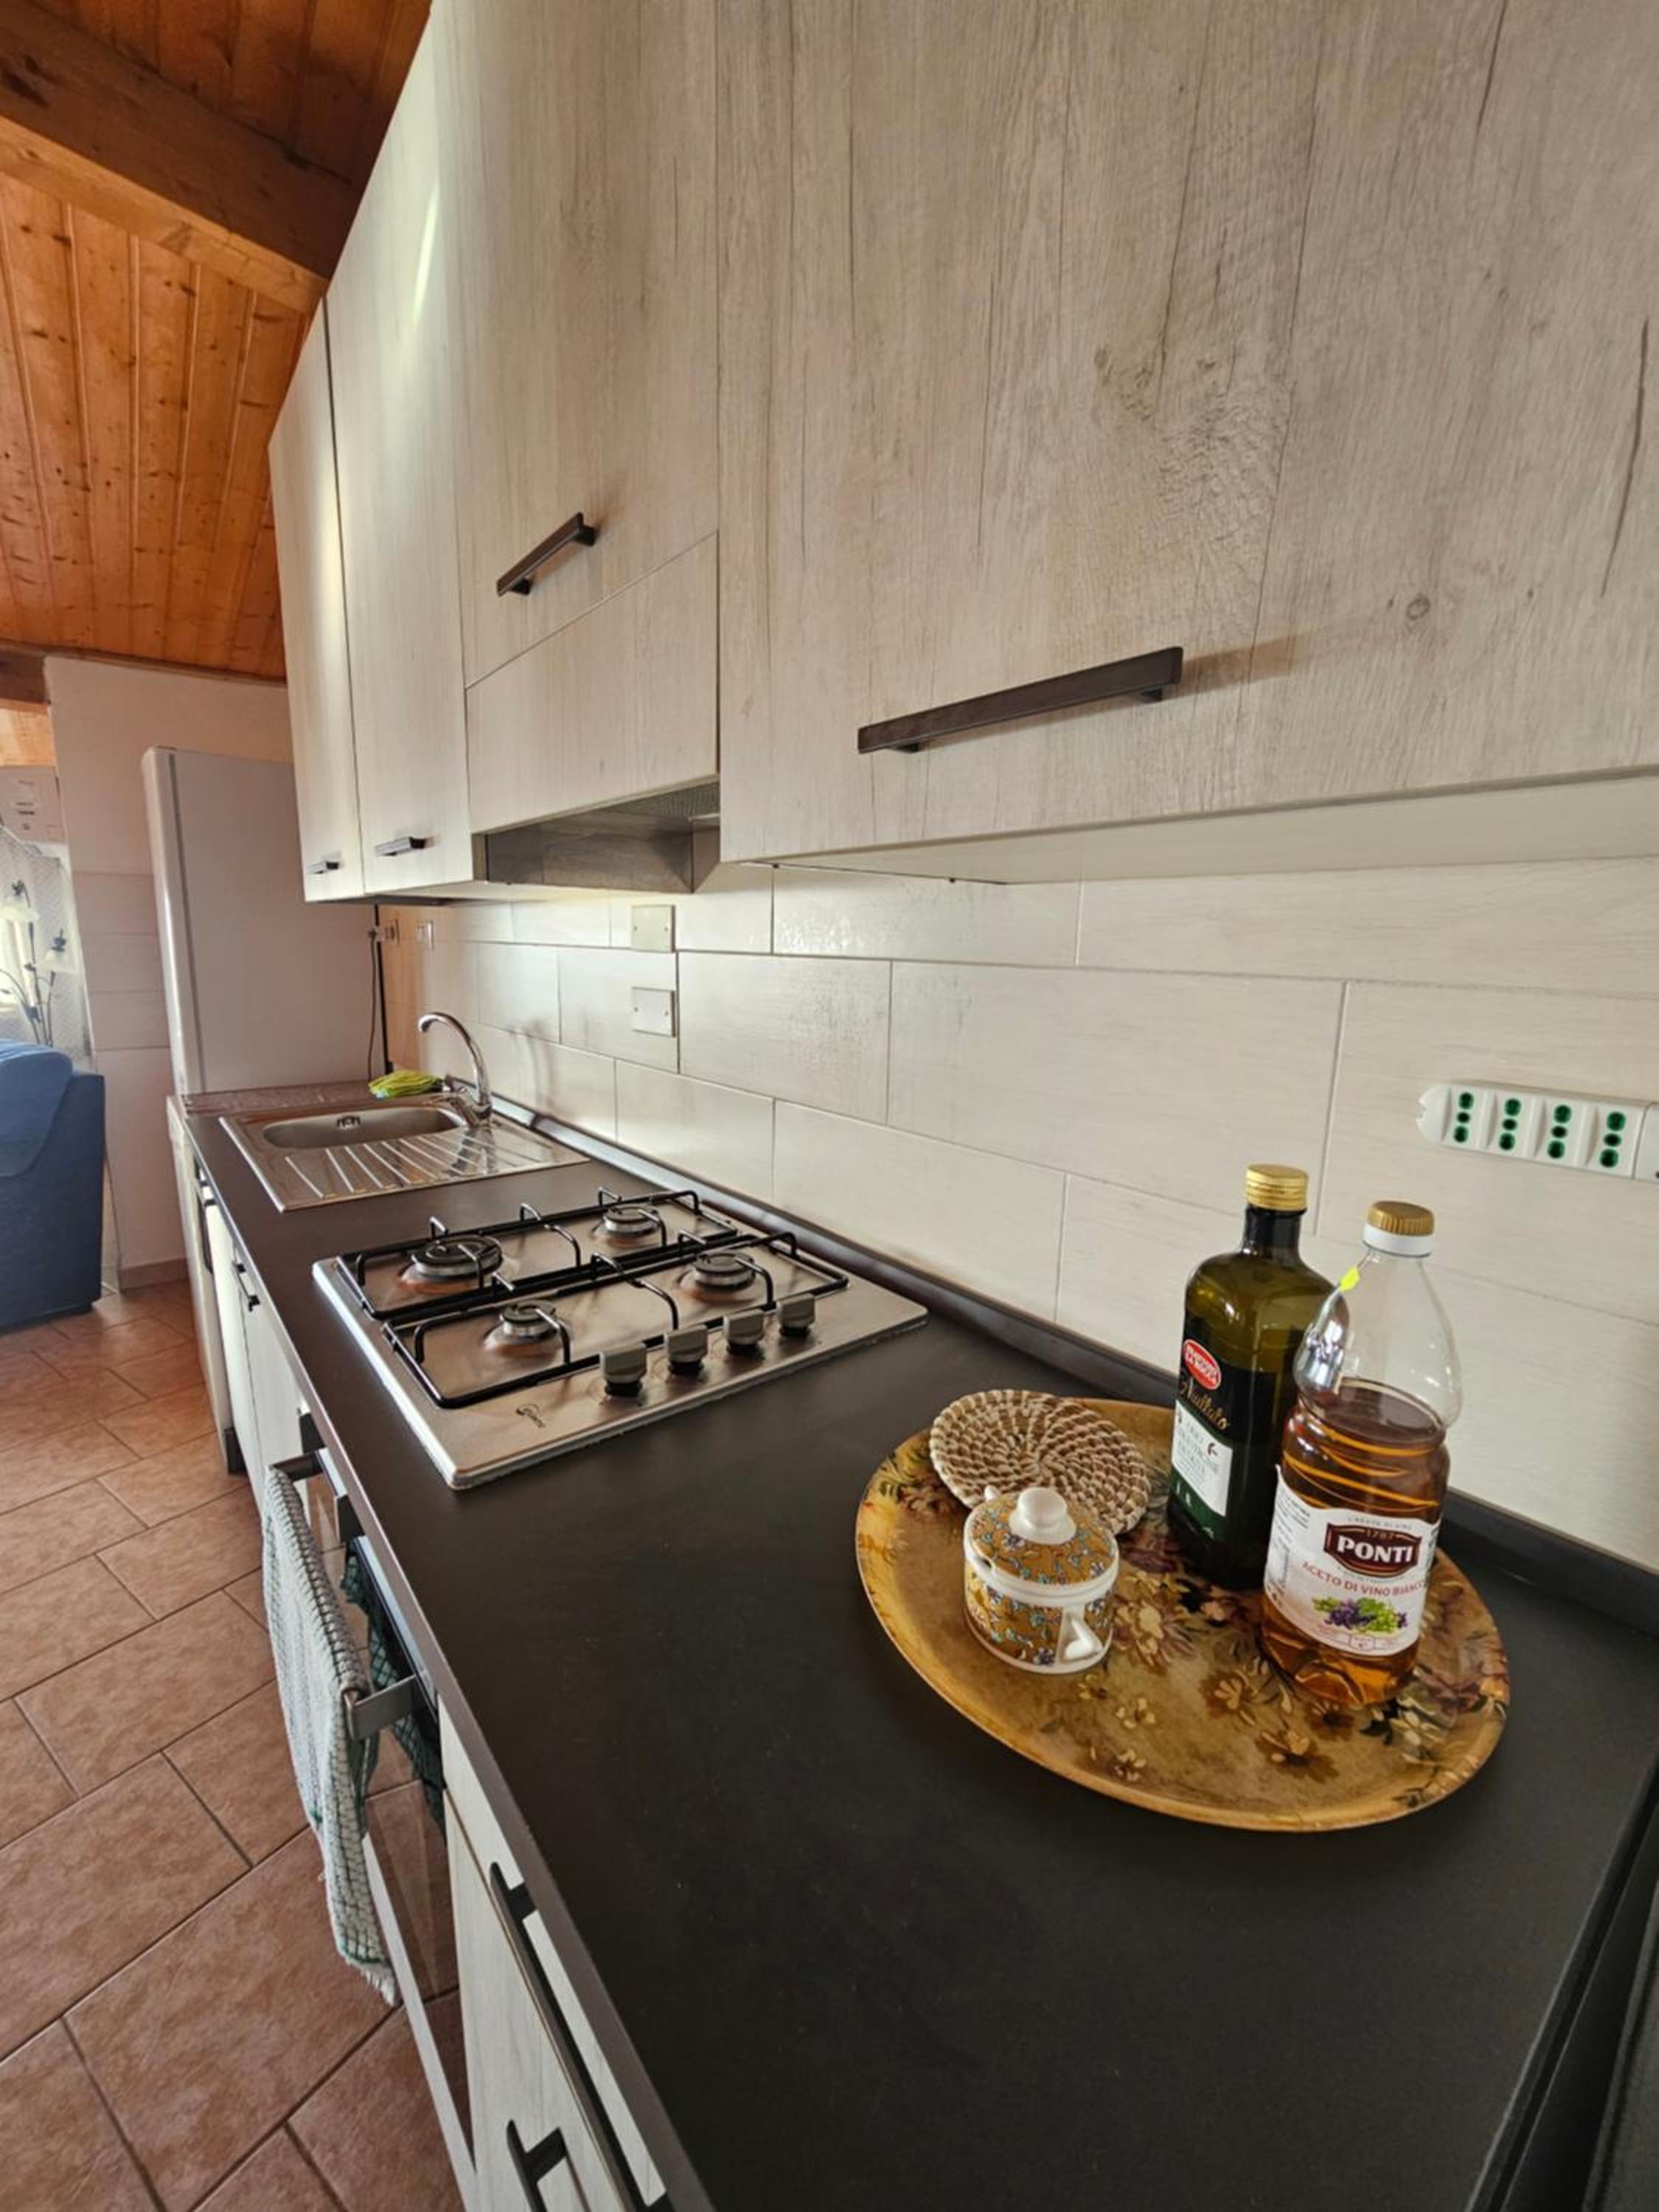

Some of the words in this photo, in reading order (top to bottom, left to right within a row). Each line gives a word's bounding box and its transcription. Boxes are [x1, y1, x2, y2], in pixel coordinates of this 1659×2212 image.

[1336, 1534, 1413, 1564] PONTI
[1299, 1561, 1342, 1586] ACETO
[1345, 1580, 1357, 1593] DI
[1360, 1585, 1391, 1598] VINO
